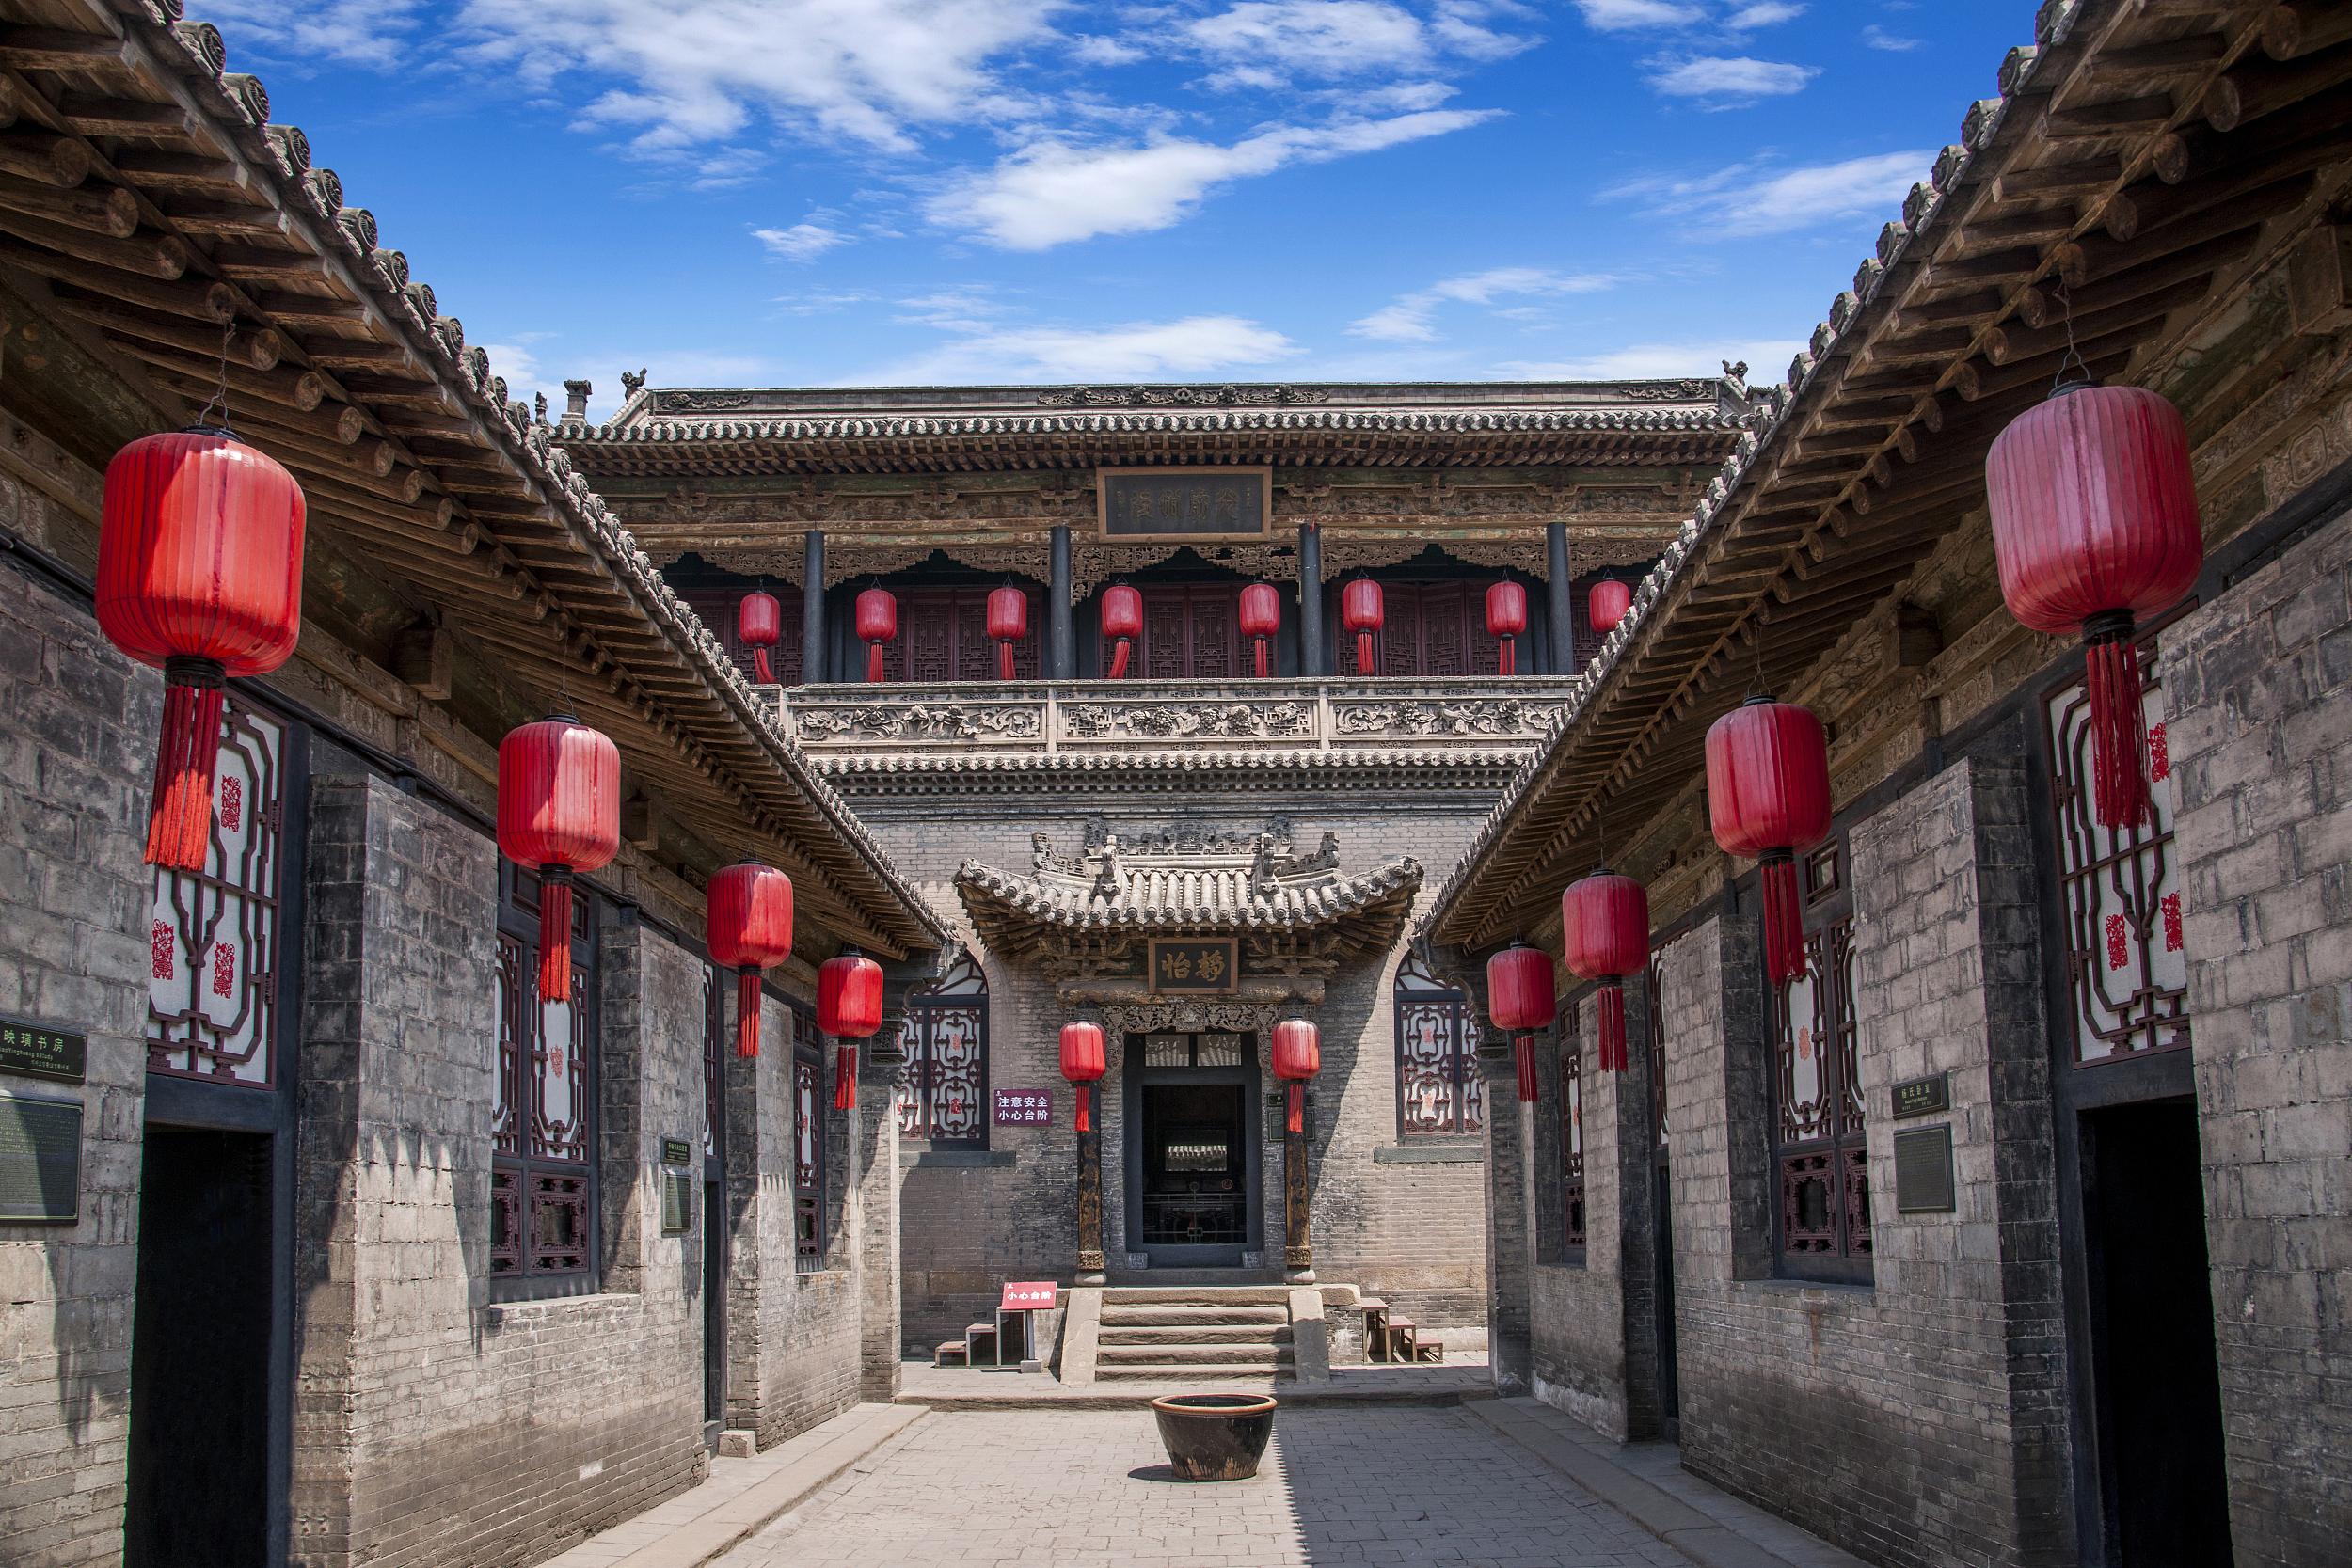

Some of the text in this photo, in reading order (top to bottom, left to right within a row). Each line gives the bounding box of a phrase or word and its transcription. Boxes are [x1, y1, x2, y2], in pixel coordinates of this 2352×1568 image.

[997, 1096, 1049, 1108] 注意安全
[997, 1109, 1049, 1121] 小心台阶
[1007, 1291, 1052, 1301] 小心台阶
